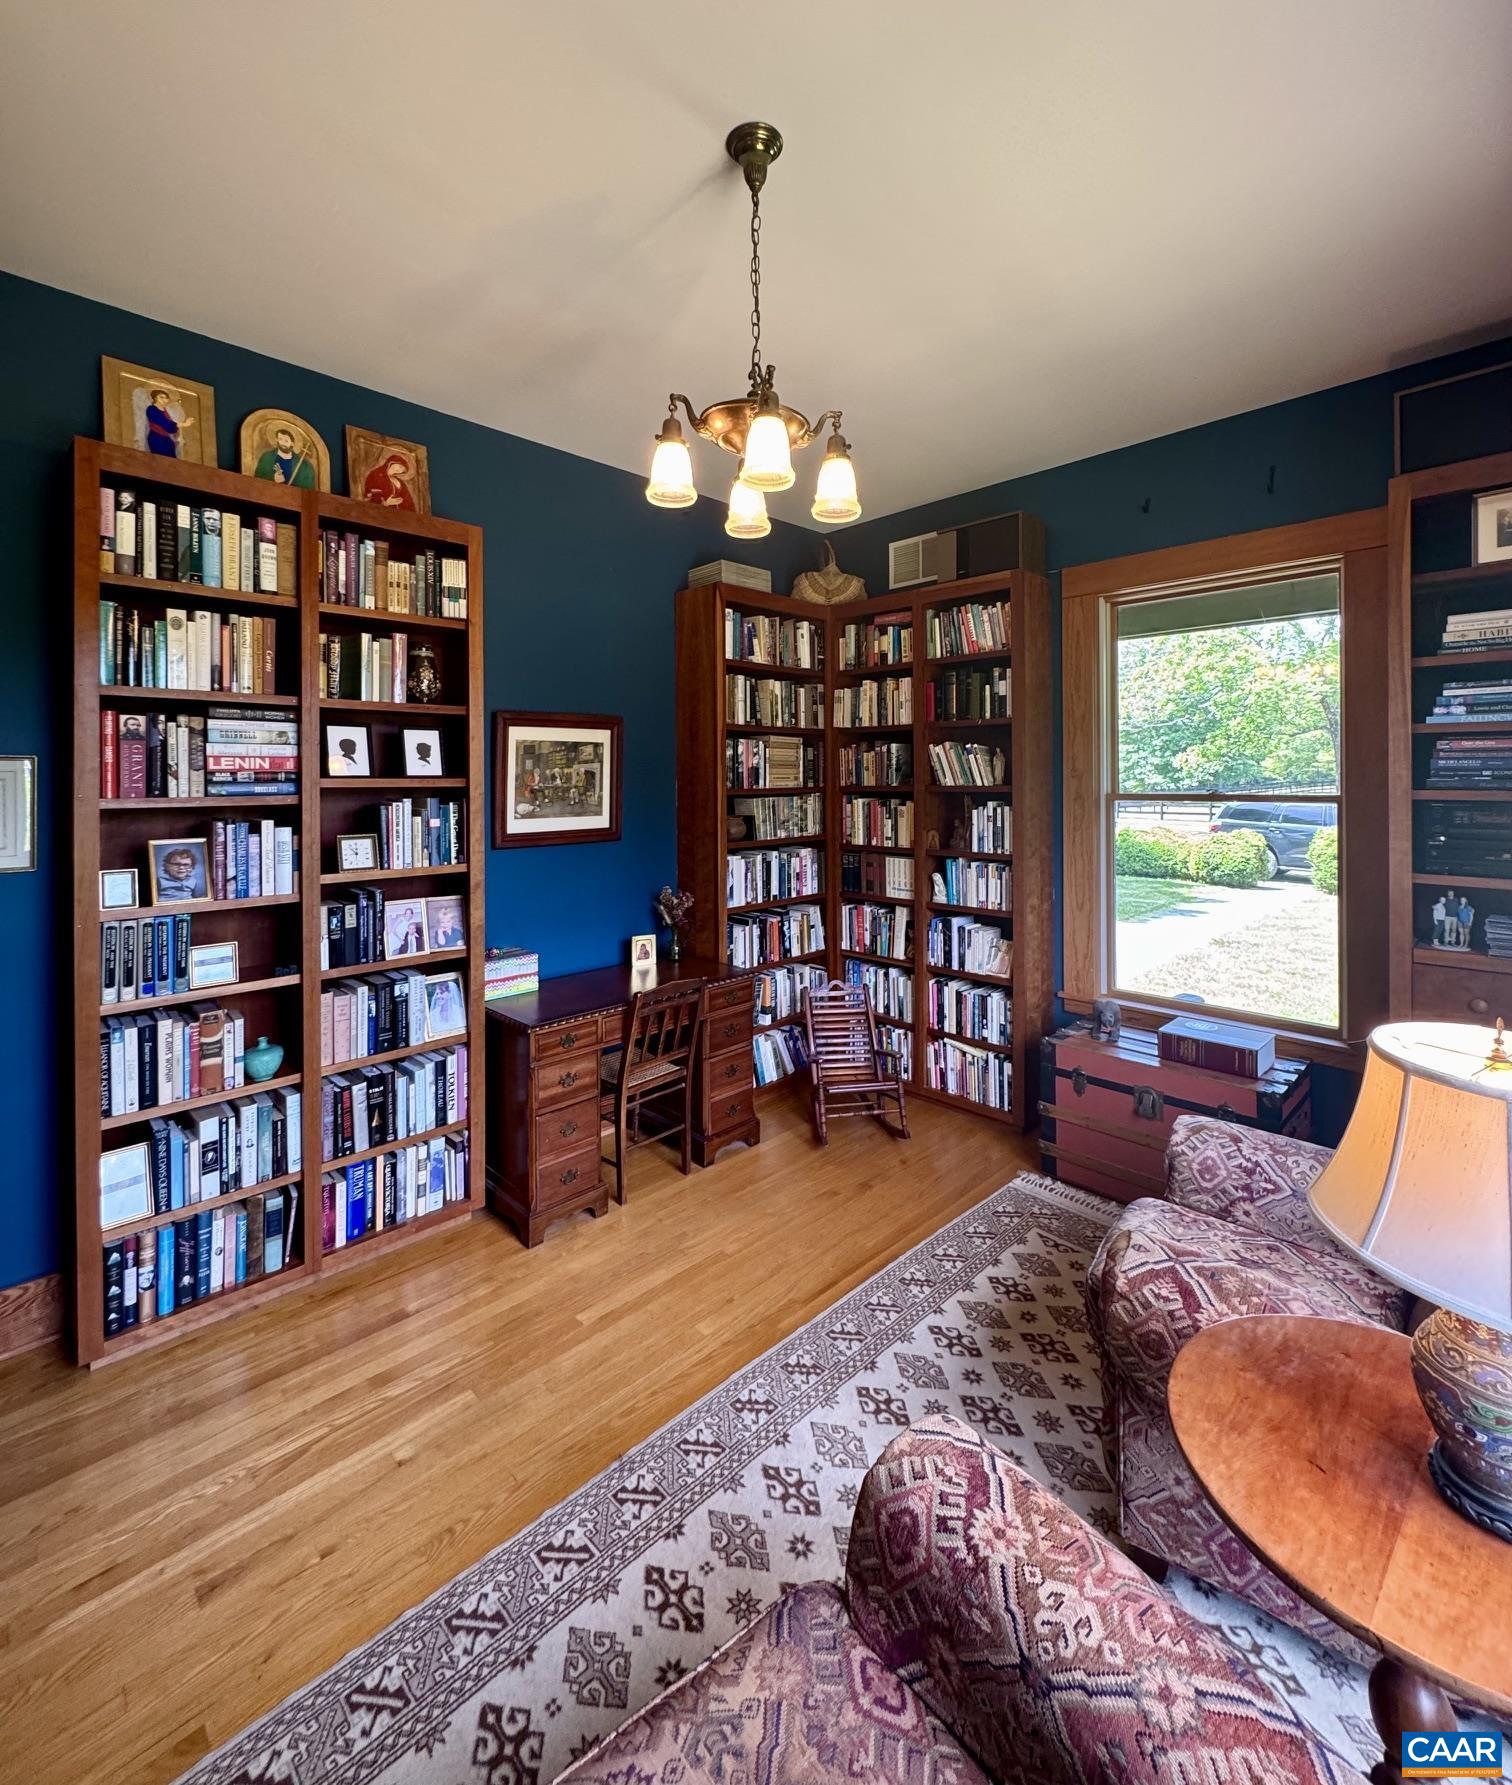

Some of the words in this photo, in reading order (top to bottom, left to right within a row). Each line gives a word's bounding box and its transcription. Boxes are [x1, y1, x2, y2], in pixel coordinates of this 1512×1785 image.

[1479, 628, 1512, 639] HABI
[131, 744, 143, 790] GRANT
[208, 757, 270, 770] LENIN
[165, 1056, 174, 1084] WOMAN
[448, 1071, 456, 1111] TOLKIEN
[158, 1158, 168, 1177] DAYS
[158, 1177, 168, 1206] QUEEN
[353, 1165, 365, 1201] TRUMAN
